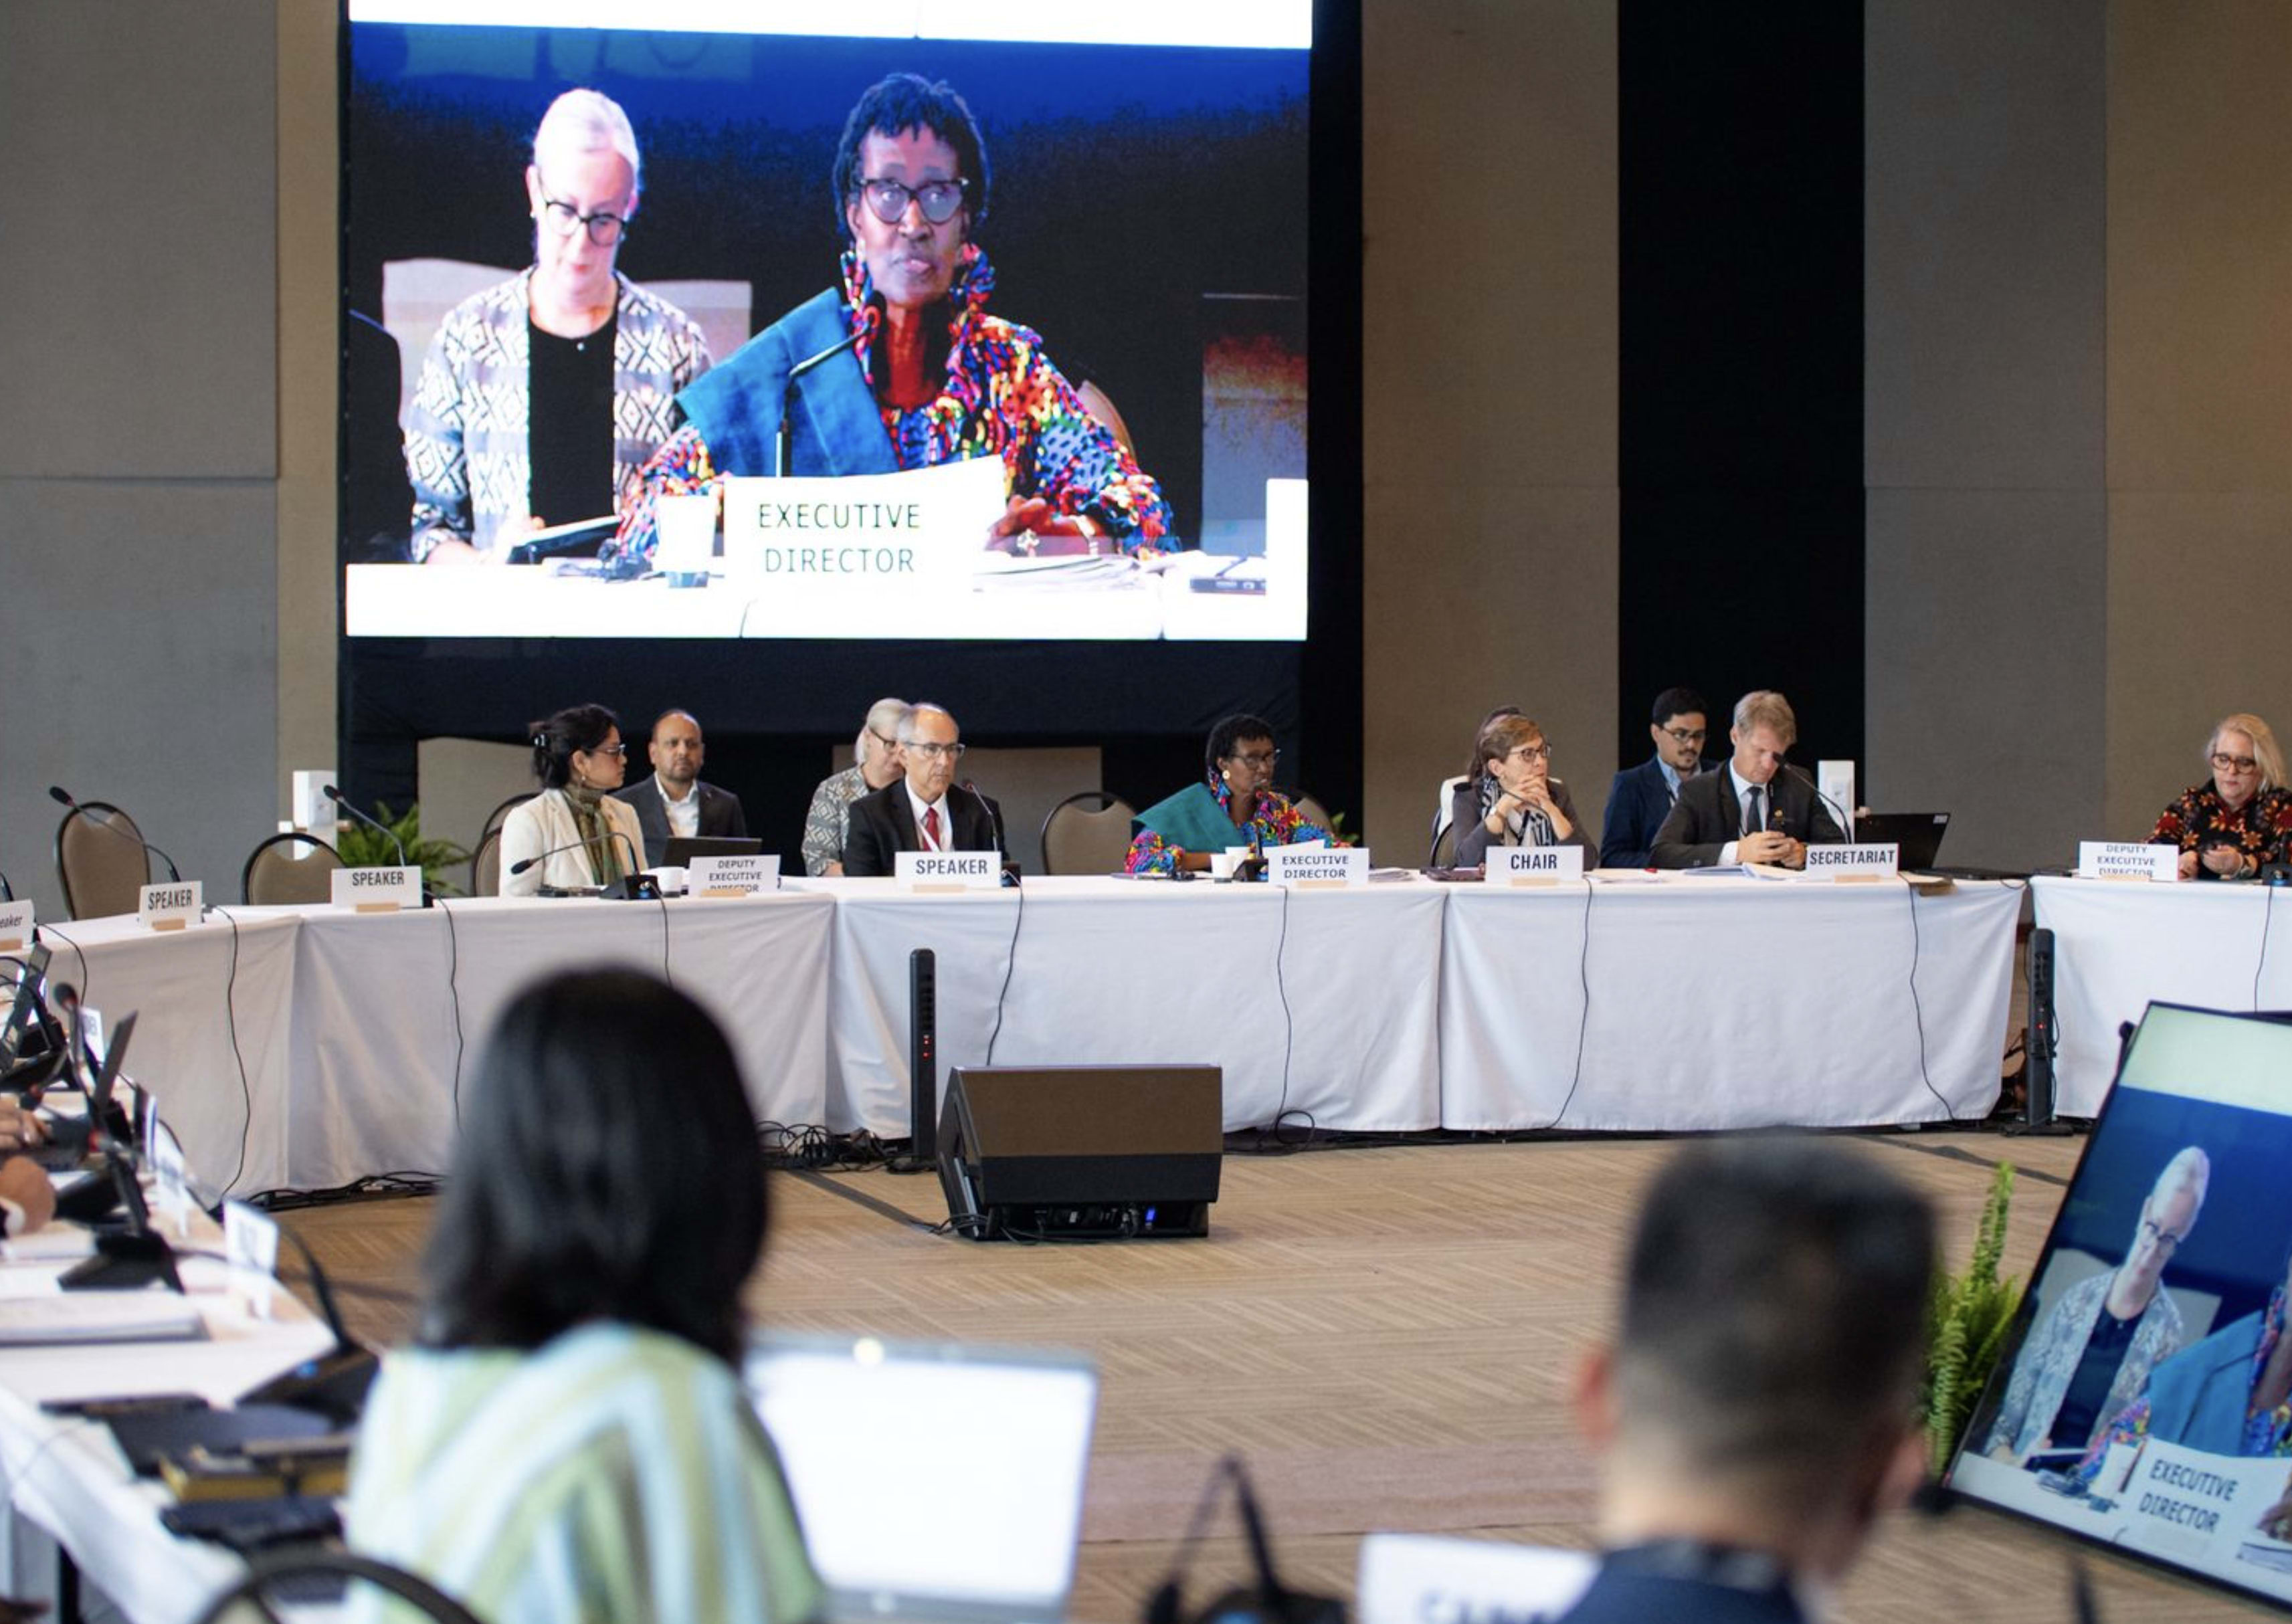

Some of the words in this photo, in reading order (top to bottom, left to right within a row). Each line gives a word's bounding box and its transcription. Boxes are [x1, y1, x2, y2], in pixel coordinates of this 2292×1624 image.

[759, 503, 920, 528] EXECUTIVE
[765, 548, 914, 573] DIRECTOR
[2107, 844, 2147, 853] DEPUTY
[717, 859, 756, 870] DEPUTY
[1282, 854, 1349, 866] EXECUTIVE
[1511, 853, 1557, 870] CHAIR
[1809, 849, 1895, 865] SECRETARIAT
[2097, 855, 2156, 866] EXECUTIVE
[915, 858, 988, 875] SPEAKER
[1284, 869, 1347, 879] DIRECTOR
[352, 871, 405, 886] SPEAKER
[709, 871, 763, 882] EXECUTIVE
[148, 888, 193, 910] SPEAKER
[2150, 1458, 2238, 1502] EXECUTIVE
[2139, 1492, 2220, 1533] DIRECTOR
